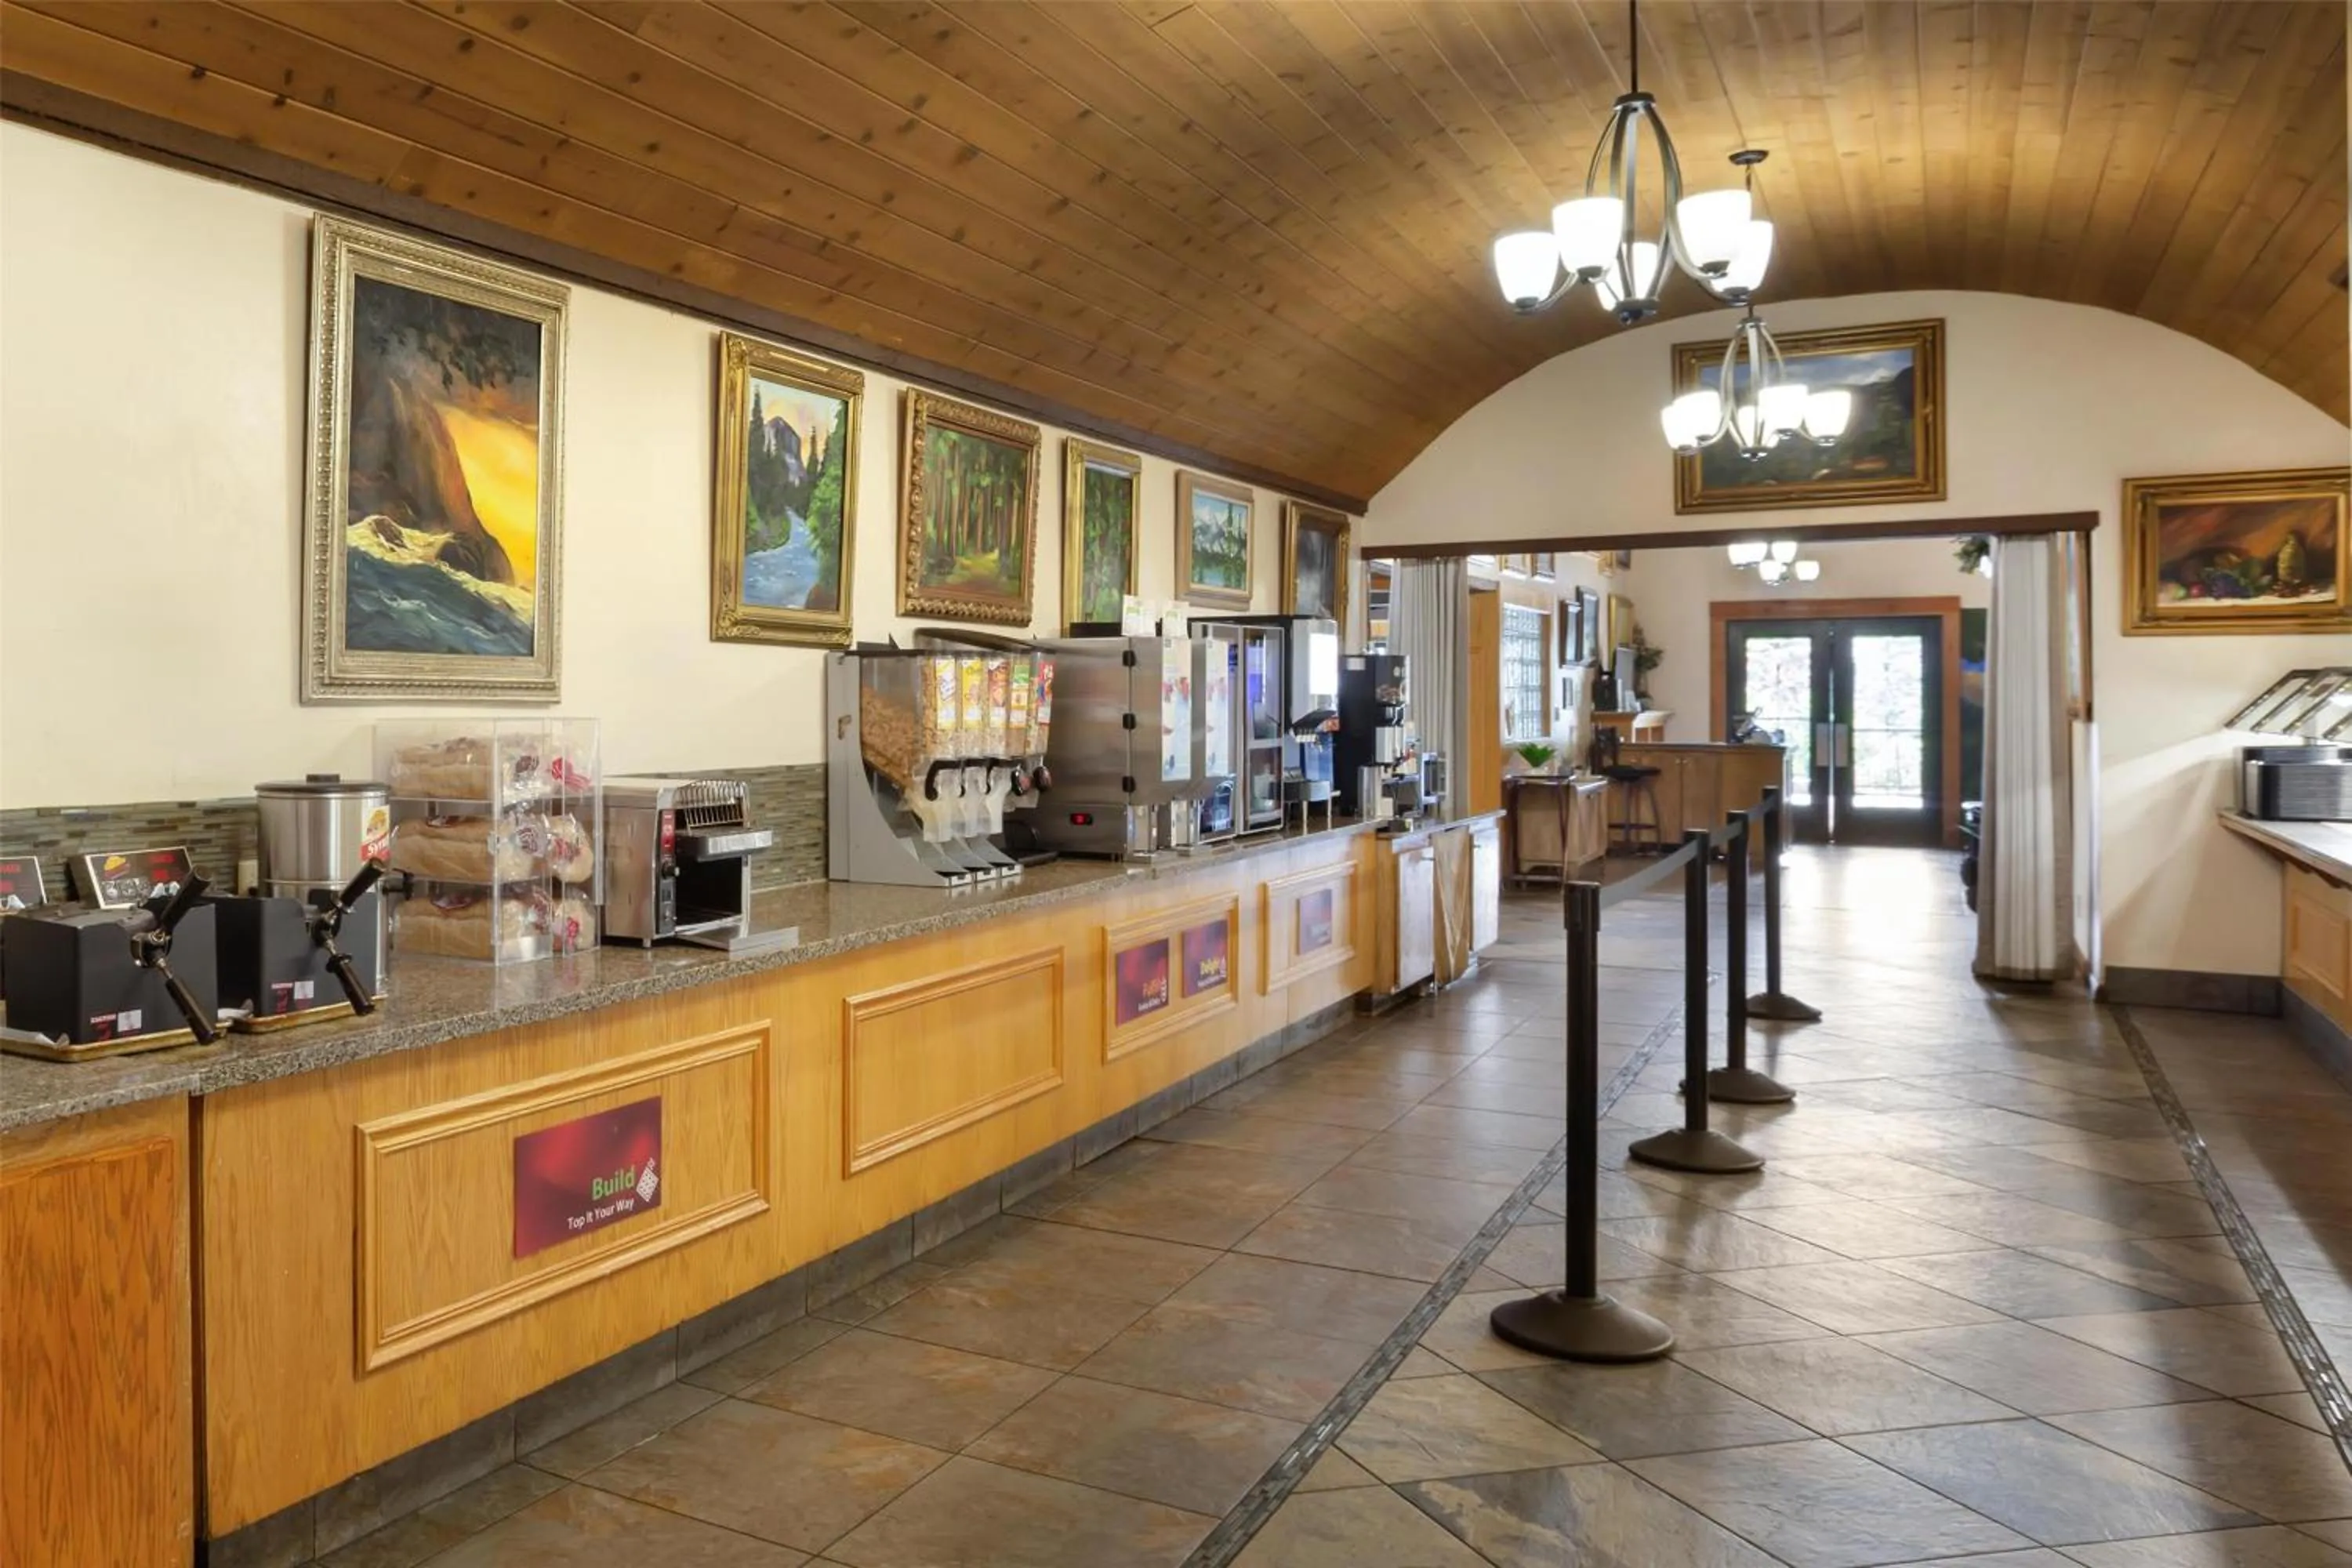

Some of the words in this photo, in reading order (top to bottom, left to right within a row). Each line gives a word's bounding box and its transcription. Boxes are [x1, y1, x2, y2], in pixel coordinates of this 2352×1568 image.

[592, 1165, 635, 1200] Build
[568, 1217, 585, 1229] Top
[594, 1205, 615, 1219] Your
[615, 1198, 634, 1211] Way
